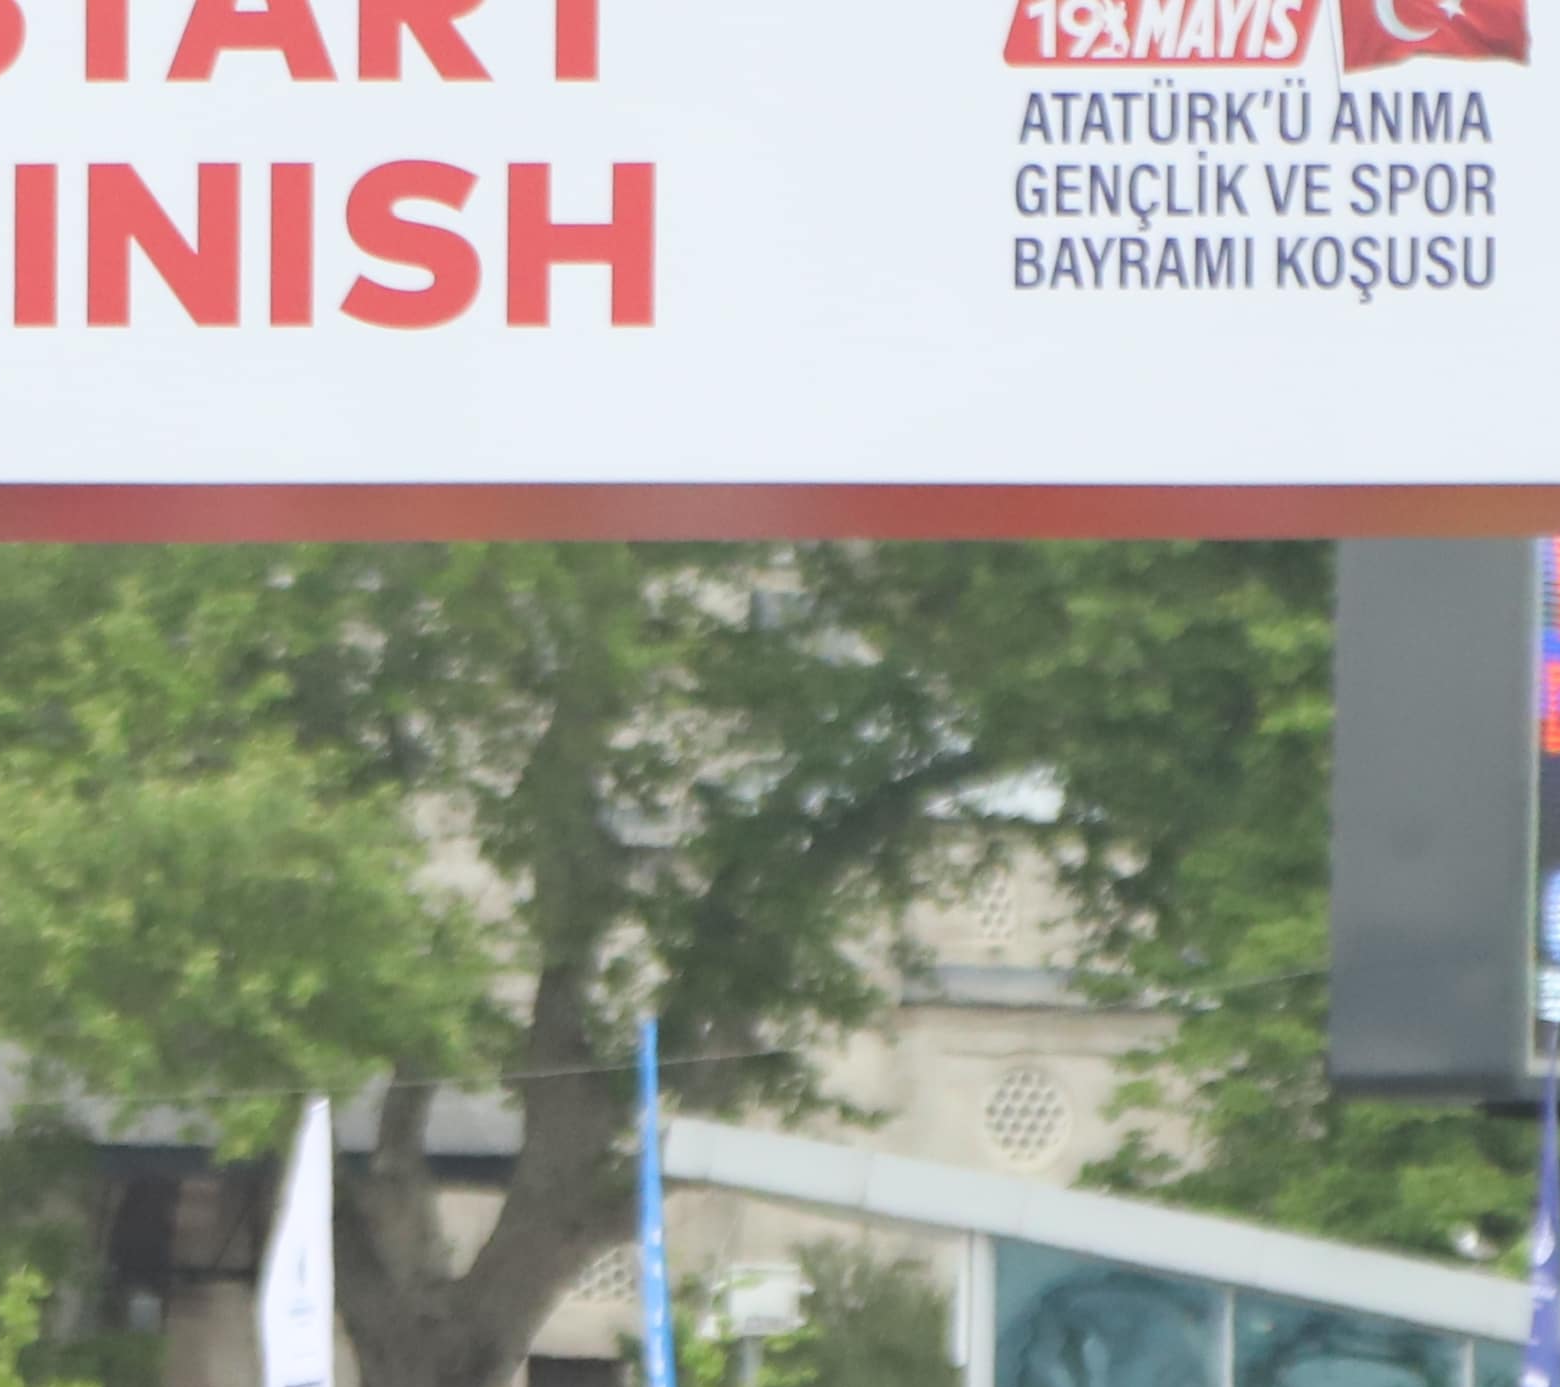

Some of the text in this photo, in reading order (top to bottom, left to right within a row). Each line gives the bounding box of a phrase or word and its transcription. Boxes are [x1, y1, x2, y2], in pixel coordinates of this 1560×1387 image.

[1132, 0, 1300, 60] MAYIS
[1018, 78, 1493, 145] ATATÜRK'Ü ANMA
[1013, 150, 1498, 231] GENÇLİK VE SPOR
[1013, 236, 1498, 304] BAYRAMI KOŞUSU
